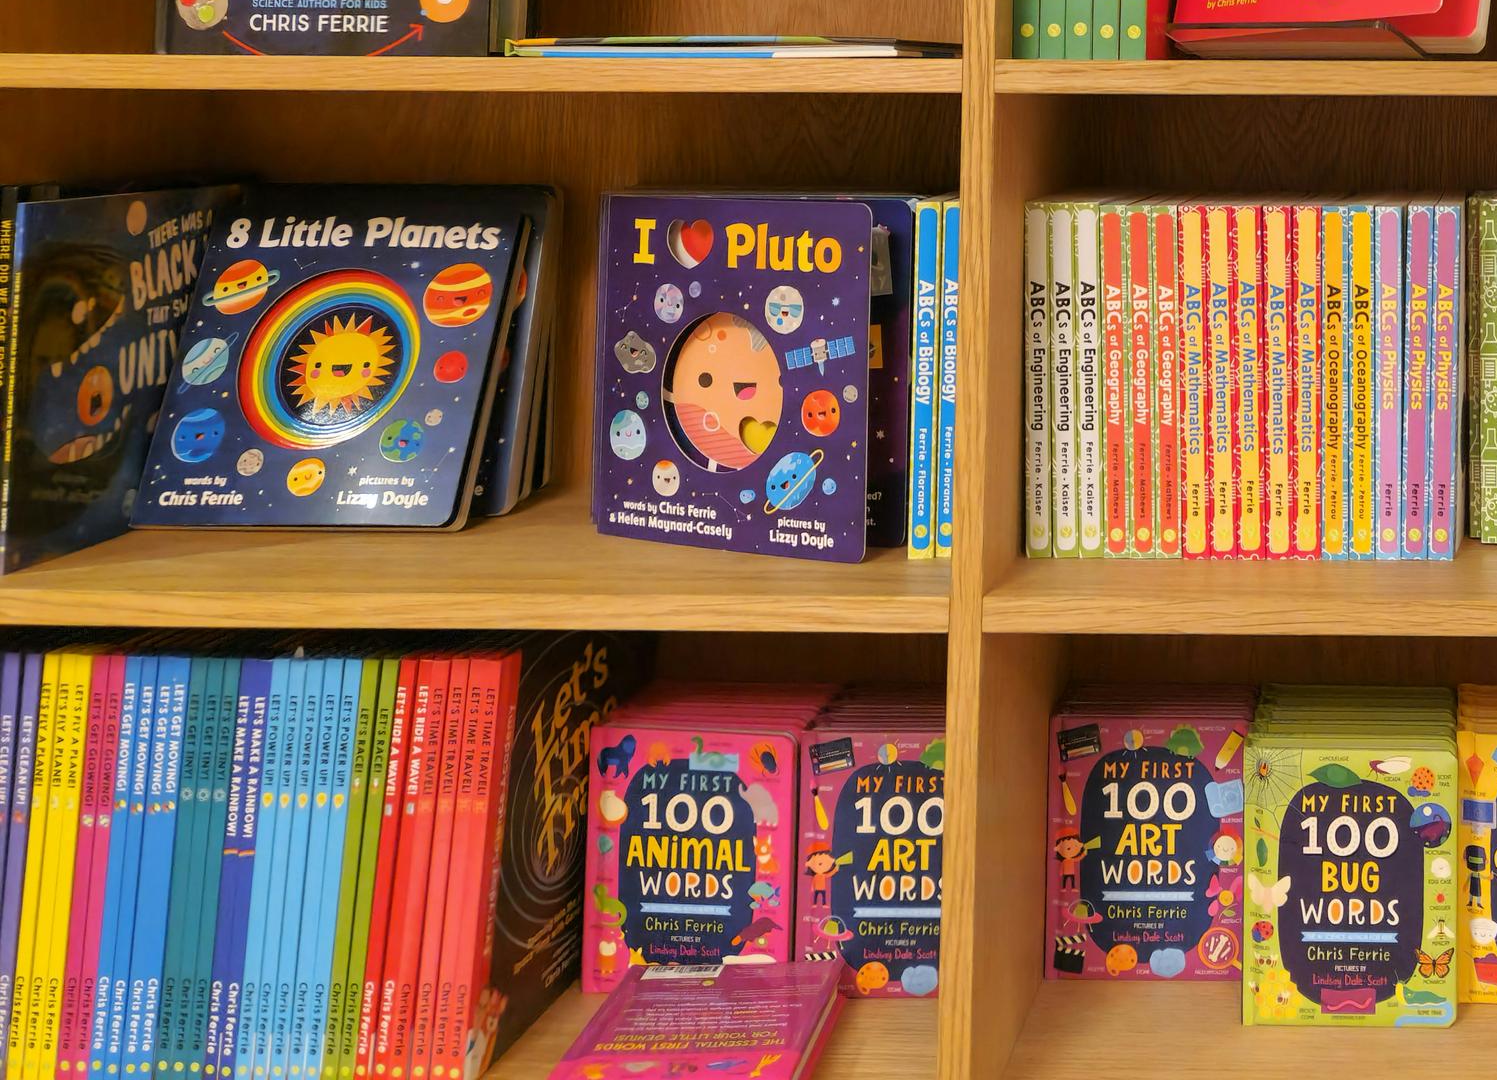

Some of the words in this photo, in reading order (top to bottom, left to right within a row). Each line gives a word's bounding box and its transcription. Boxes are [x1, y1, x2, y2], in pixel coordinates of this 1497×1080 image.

[252, 0, 293, 8] SCIENCE
[297, 0, 336, 8] AUTHOR
[341, 0, 360, 9] FOR
[365, 0, 386, 9] KIDS
[1207, 0, 1215, 9] by
[250, 14, 309, 32] CHRIS
[318, 15, 388, 32] FERRIE
[226, 218, 250, 249] 8
[259, 215, 353, 249] Little
[364, 215, 500, 250] Planets
[632, 218, 656, 265] I
[725, 222, 842, 273] Pluto
[919, 279, 934, 328] ABCs
[1029, 281, 1045, 328] ABCs
[1105, 284, 1121, 331] ABCs
[1186, 284, 1201, 331] ABCs
[920, 333, 928, 341] of
[1033, 332, 1042, 345] of
[1110, 334, 1118, 345] of
[1188, 336, 1196, 347] of
[919, 344, 934, 406] Biology
[1032, 347, 1046, 432] Engineering
[1108, 347, 1122, 425] Geography
[1186, 351, 1201, 455] Mathematics
[1034, 441, 1042, 473] Ferrie
[159, 491, 200, 506] Chris
[202, 491, 243, 507] Ferrie
[336, 492, 378, 509] Lizzy
[381, 491, 428, 506] Doyle
[624, 500, 645, 511] words
[647, 503, 657, 513] by
[659, 501, 685, 515] Chris
[688, 505, 716, 519] Ferrie
[1034, 480, 1042, 516] Kaiser
[618, 513, 645, 527] Helen
[648, 516, 732, 540] Maynard-Casely
[172, 685, 184, 713] LET'S
[253, 697, 266, 725] LET'S
[170, 715, 182, 737] GET
[249, 728, 262, 762] MAKE
[165, 741, 179, 793] MOVING!
[643, 774, 667, 790] MY
[680, 774, 732, 792] FIRST
[243, 777, 257, 838] RAINBOW!
[641, 794, 734, 834] 100
[1303, 795, 1329, 812] MY
[1342, 794, 1397, 813] FIRST
[1301, 816, 1399, 857] 100
[627, 835, 751, 871] ANIMAL
[639, 871, 733, 900] WORDS
[1323, 862, 1380, 893] BUG
[645, 917, 680, 931] Chris
[685, 919, 724, 933] Ferrie
[1300, 898, 1400, 926] WORDS
[1307, 946, 1344, 960] Chris
[1350, 947, 1391, 960] Ferrie
